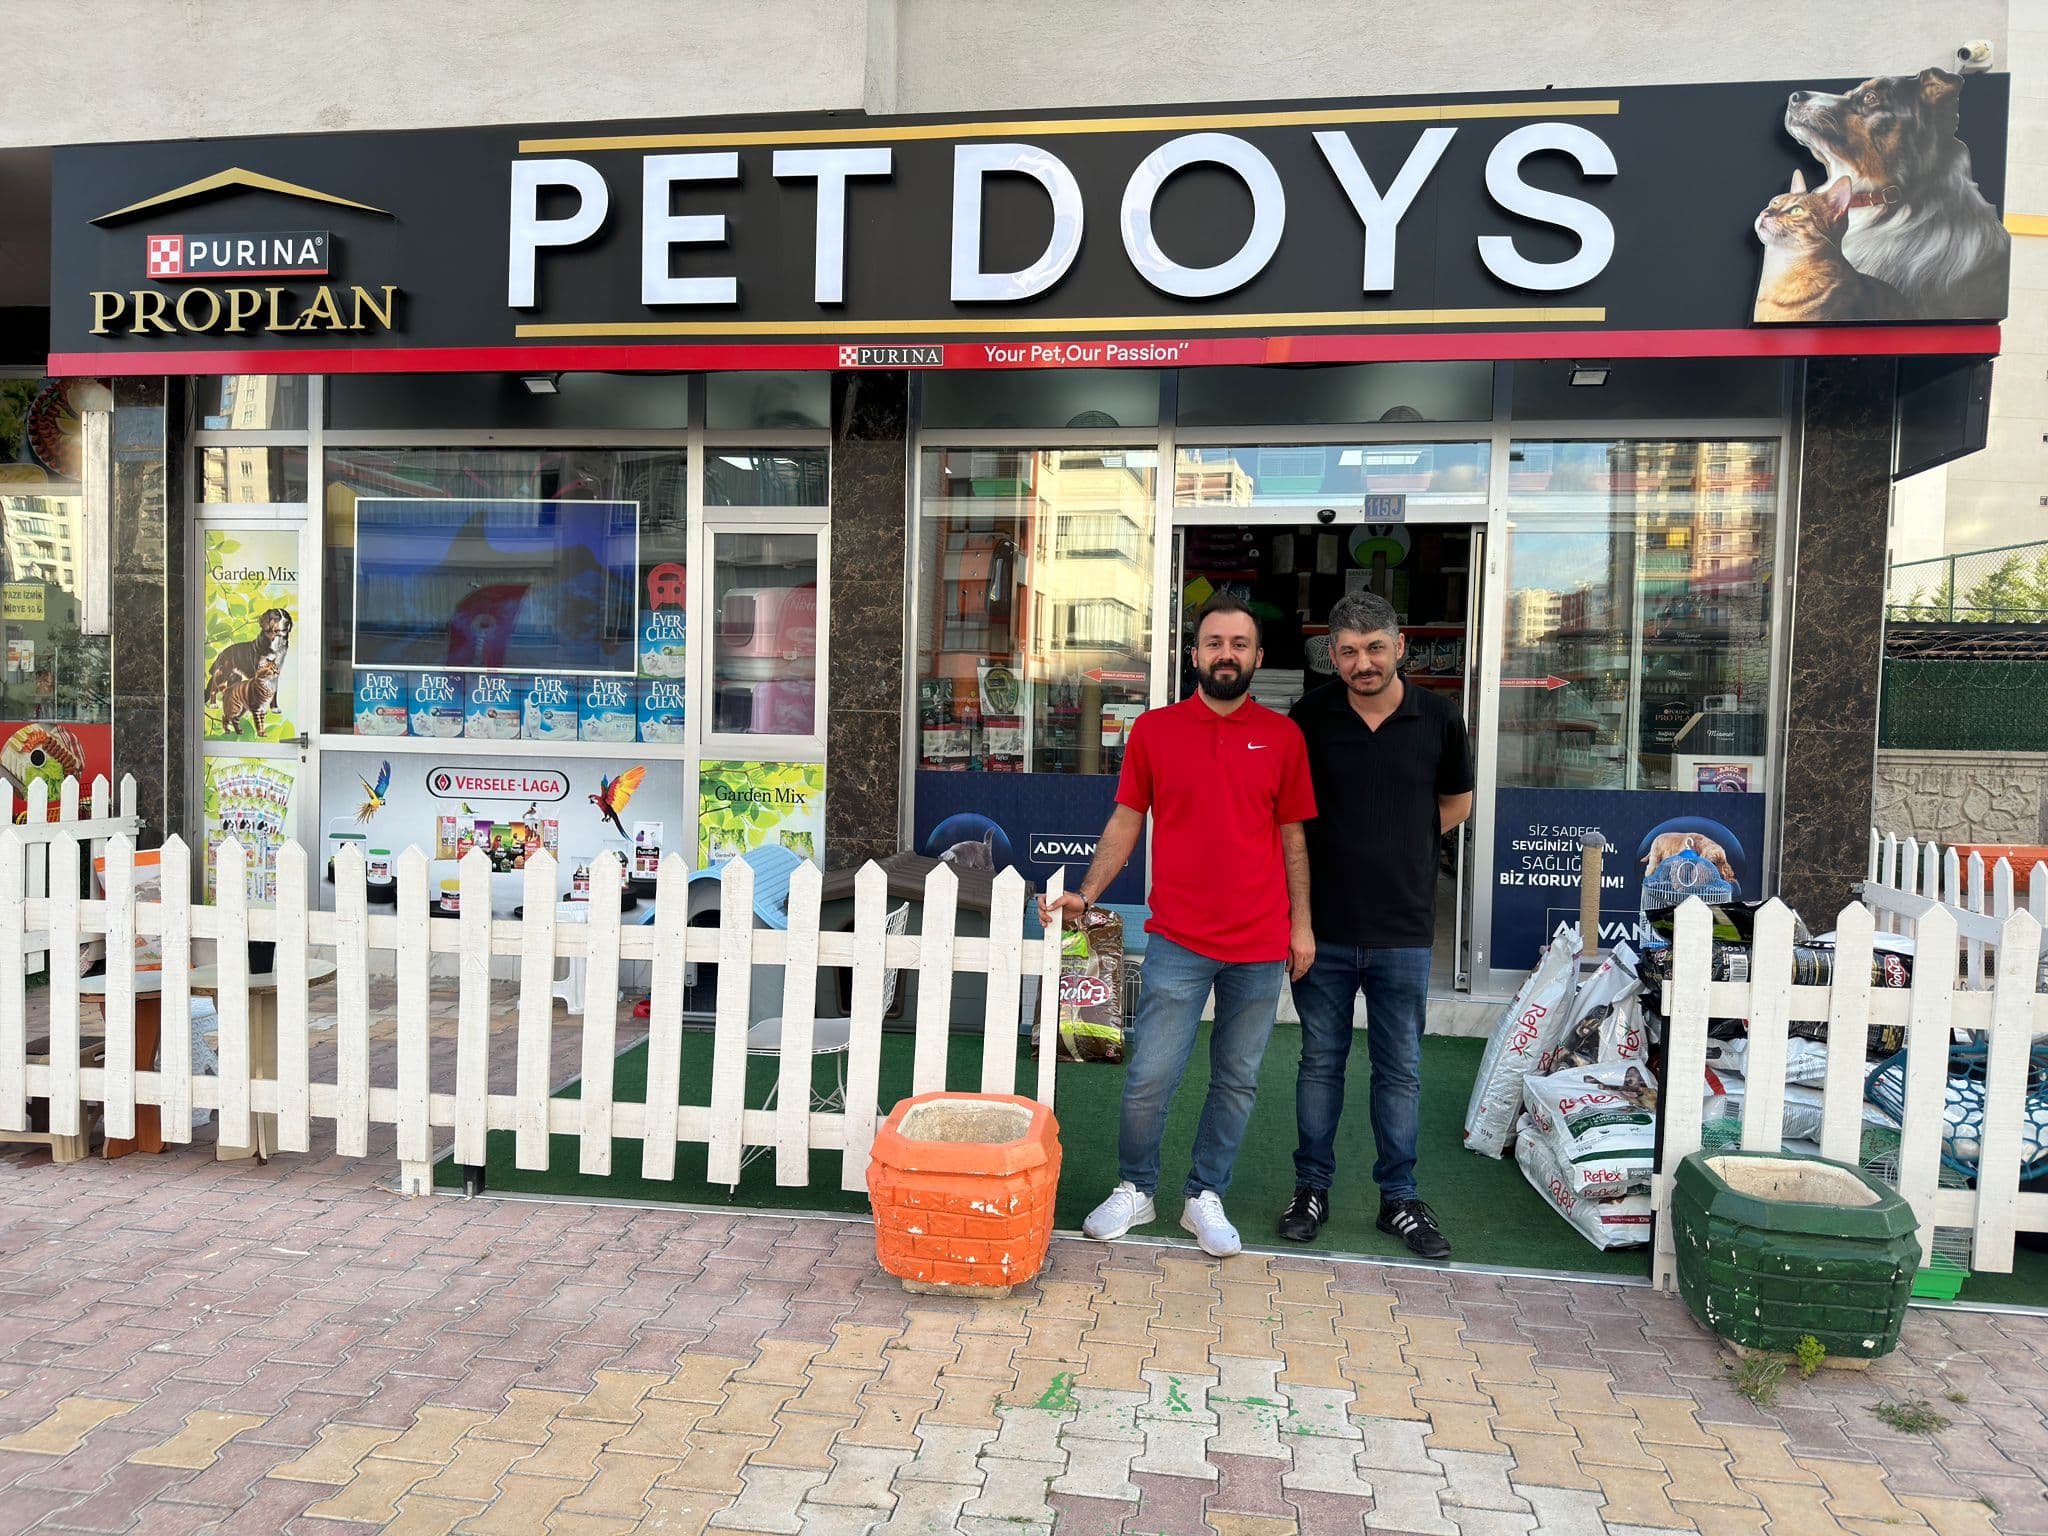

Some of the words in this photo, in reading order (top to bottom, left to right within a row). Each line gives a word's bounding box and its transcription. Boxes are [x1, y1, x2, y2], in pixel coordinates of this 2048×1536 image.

[508, 147, 893, 308] PET
[950, 122, 1618, 302] DOYS
[88, 286, 398, 334] PROPLAN
[860, 348, 940, 365] PURINA
[984, 346, 1026, 363] Your
[212, 565, 265, 581] Garden
[268, 566, 297, 581] Mix
[652, 612, 687, 631] EVER
[645, 627, 686, 642] CLEAN
[366, 673, 399, 691] EVER
[422, 674, 455, 692] EVER
[478, 675, 512, 694] EVER
[534, 677, 569, 695] EVER
[593, 679, 628, 697] EVER
[651, 681, 685, 700] EVER
[360, 687, 398, 702] CLEAN
[415, 688, 453, 703] CLEAN
[472, 690, 511, 704] CLEAN
[528, 691, 567, 706] CLEAN
[586, 693, 626, 708] CLEAN
[645, 695, 685, 711] CLEAN
[455, 775, 560, 793] VERSELE-LAGA
[714, 785, 772, 803] Garden
[774, 787, 807, 804] Mix
[1528, 823, 1549, 837] SİZ
[1033, 841, 1097, 856] ADVAN
[1512, 838, 1573, 852] SEVGİNİZİ
[1499, 870, 1525, 886] BİZ
[1528, 873, 1625, 889] KORUYIM!
[1510, 1003, 1548, 1057] Reflex
[1616, 1029, 1640, 1060] flex
[1583, 1169, 1622, 1183] Reflex
